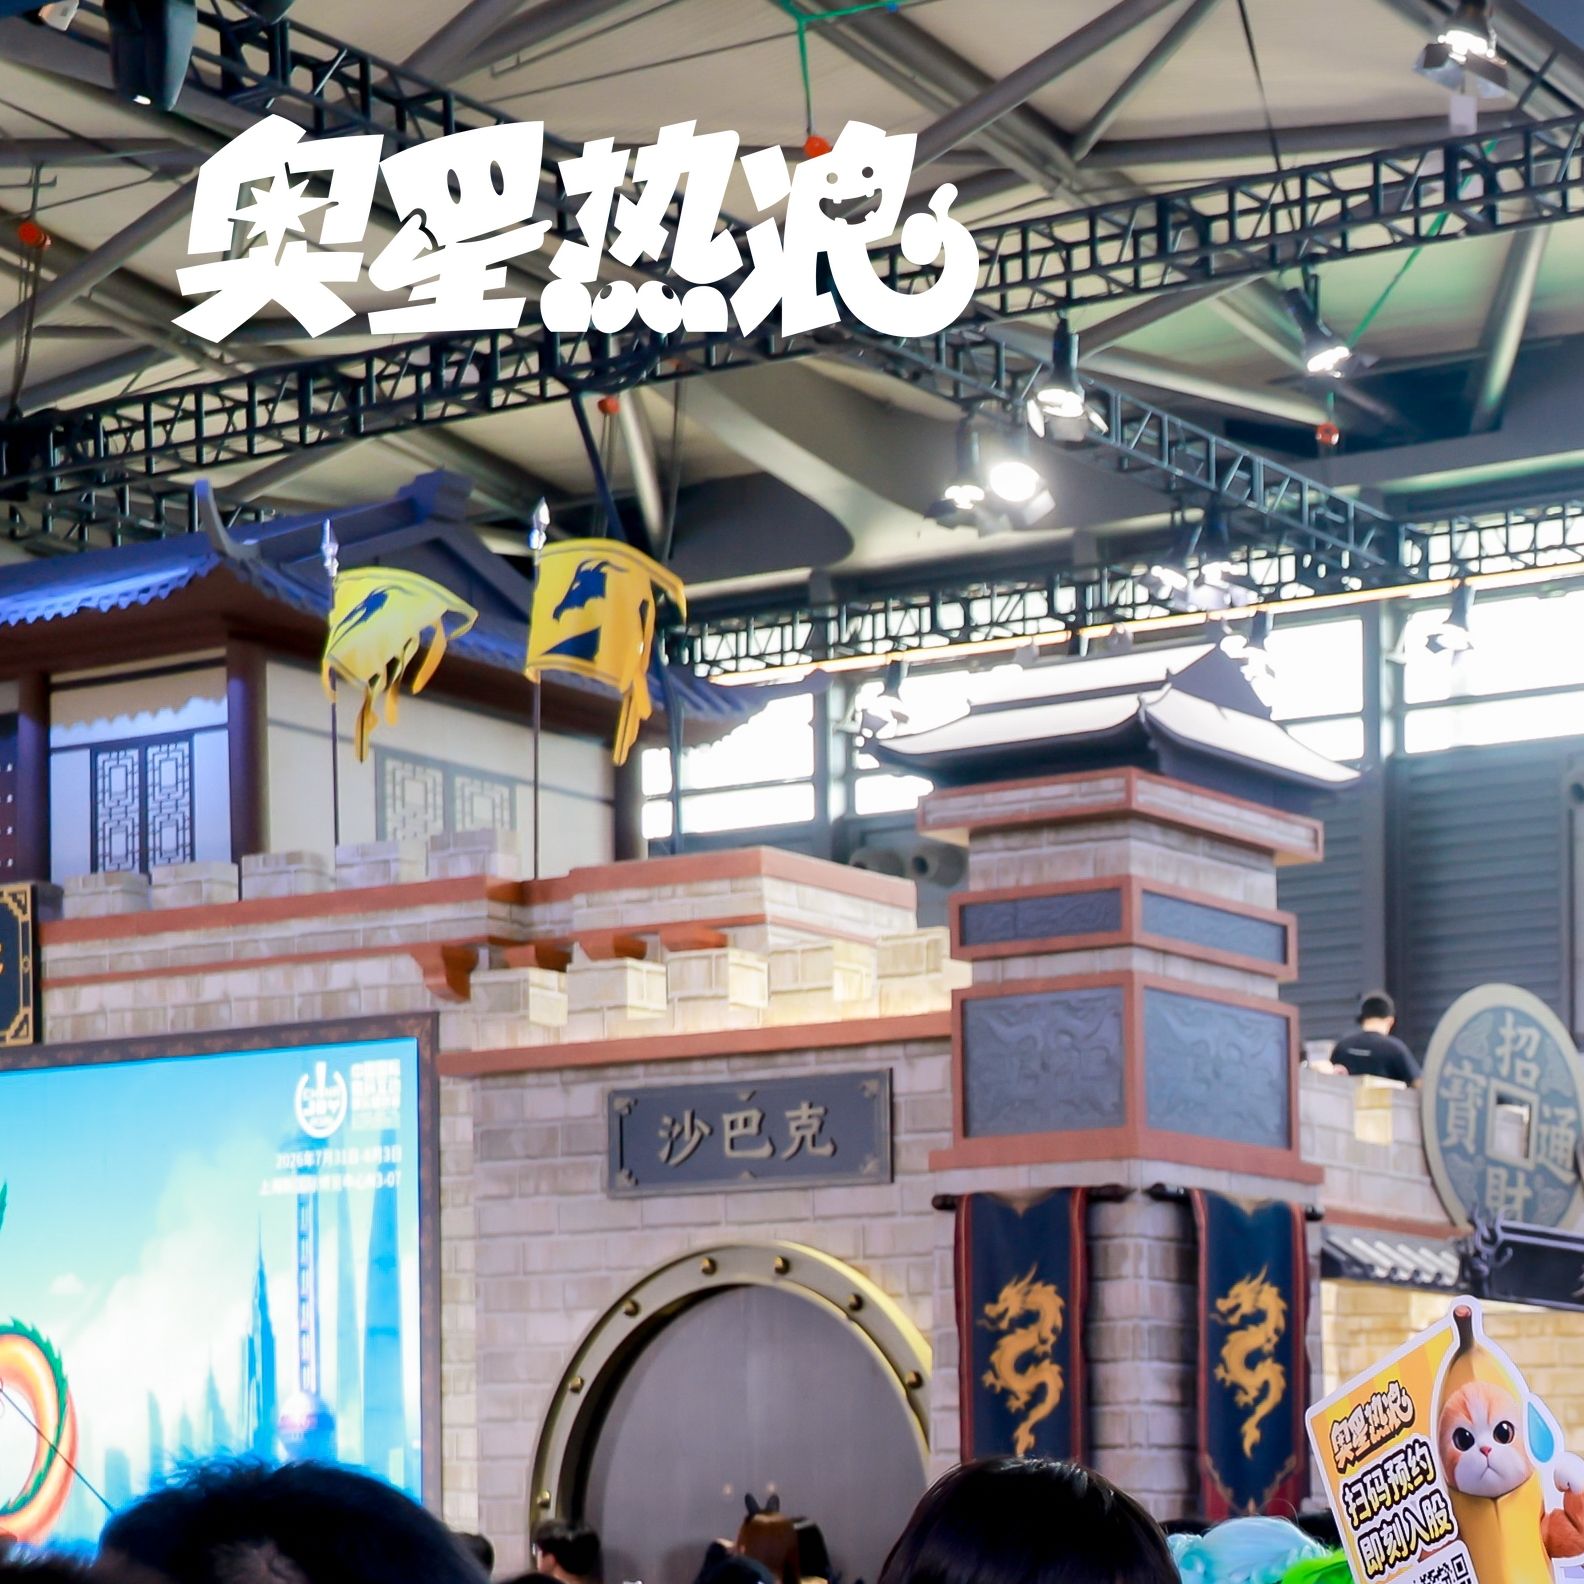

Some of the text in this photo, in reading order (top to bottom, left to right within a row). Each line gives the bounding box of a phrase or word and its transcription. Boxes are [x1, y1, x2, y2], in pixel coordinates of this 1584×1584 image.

[1495, 1011, 1541, 1087] 招
[657, 1101, 836, 1168] 沙巴克
[1330, 1380, 1416, 1474] 奥星热浪
[1342, 1438, 1437, 1531] 扫码预约
[1357, 1488, 1455, 1579] 即刻入股
